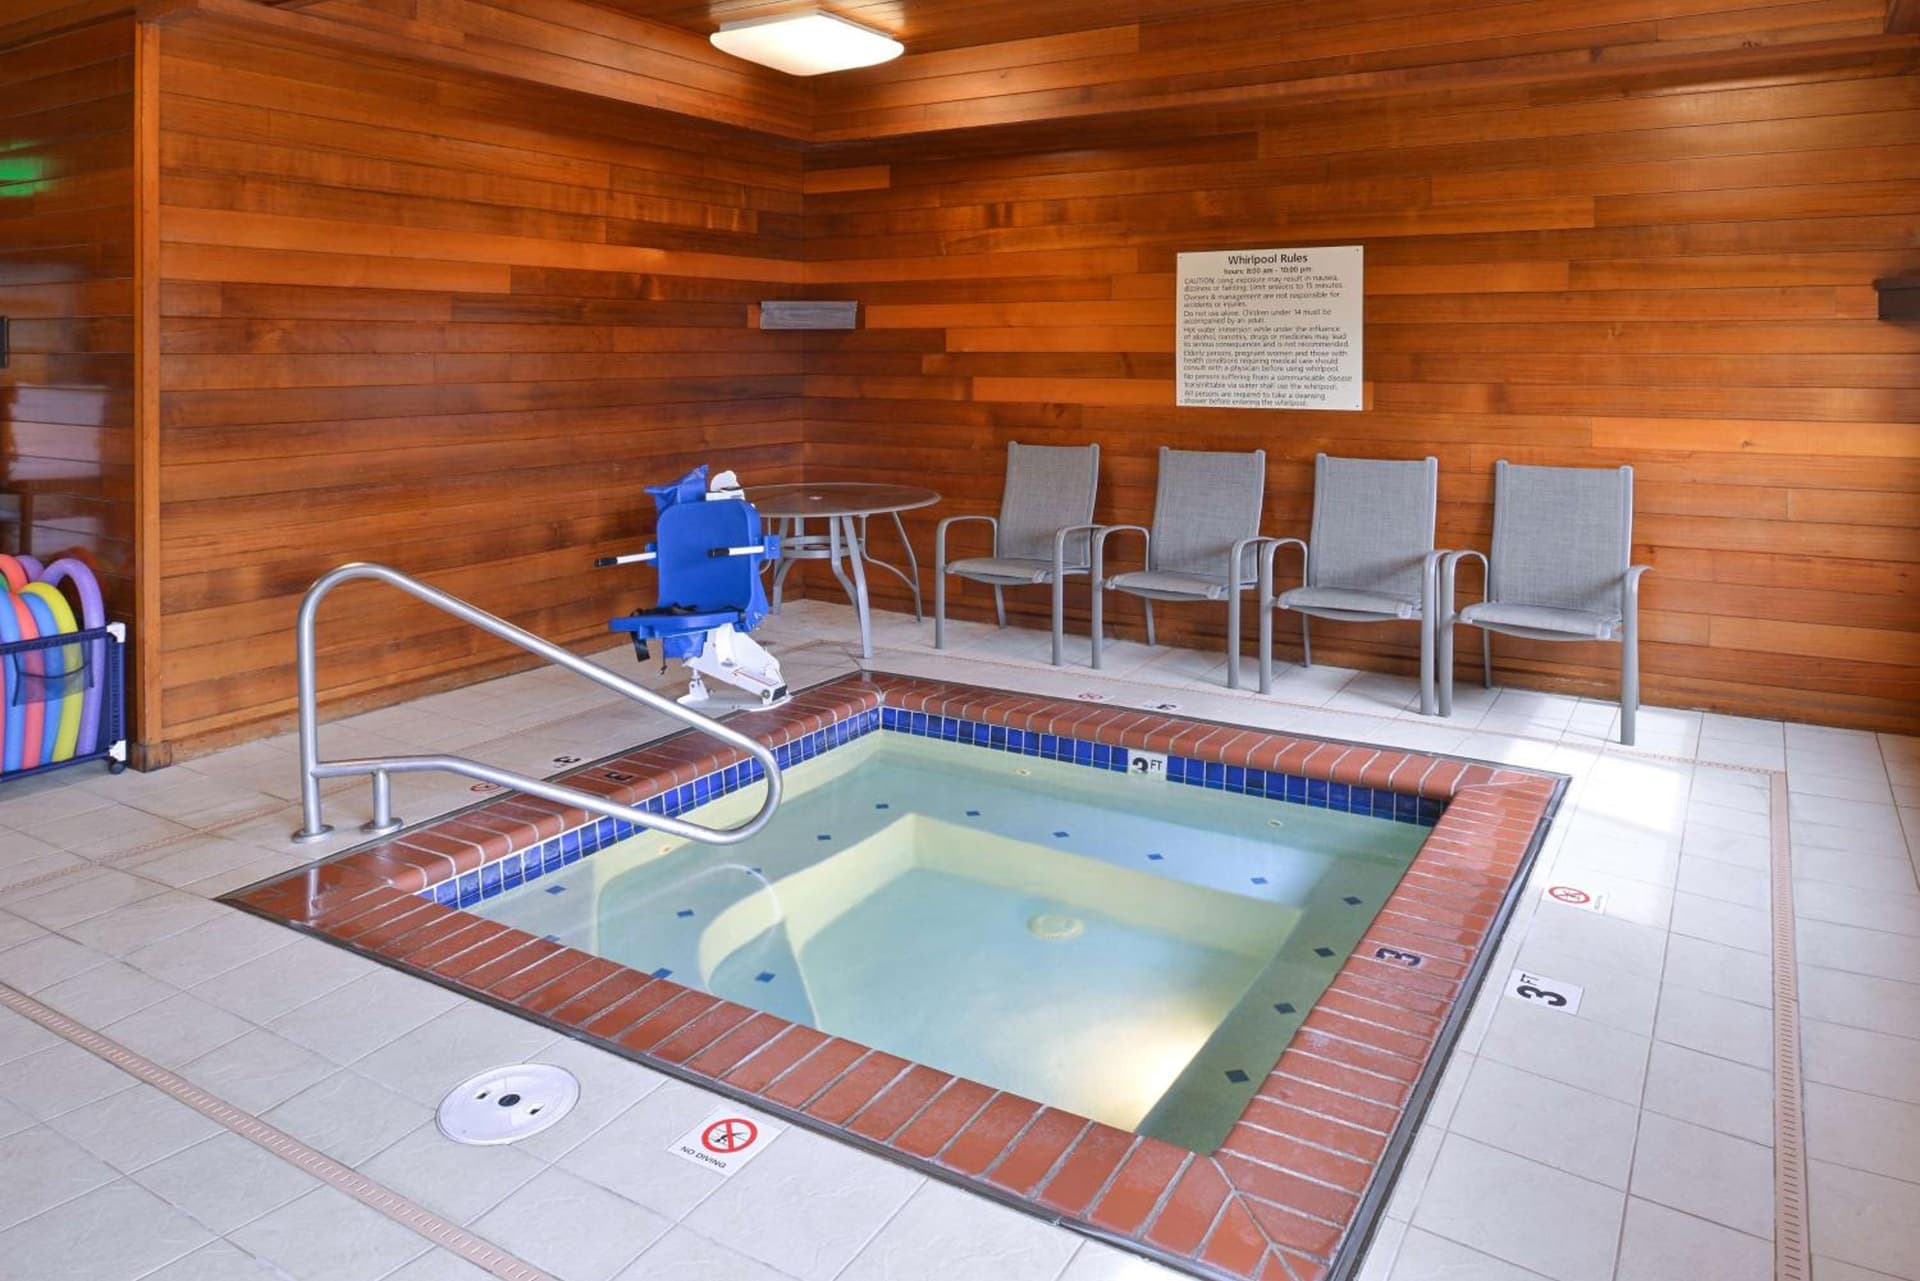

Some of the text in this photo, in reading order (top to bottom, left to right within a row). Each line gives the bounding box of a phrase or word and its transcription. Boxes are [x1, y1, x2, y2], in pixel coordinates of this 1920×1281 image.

[1228, 253, 1308, 265] Whirlpool Rules
[1151, 760, 1163, 770] FT
[1375, 947, 1421, 967] 3
[1517, 973, 1567, 1007] 3 FT
[681, 1146, 727, 1168] NO DIVING
